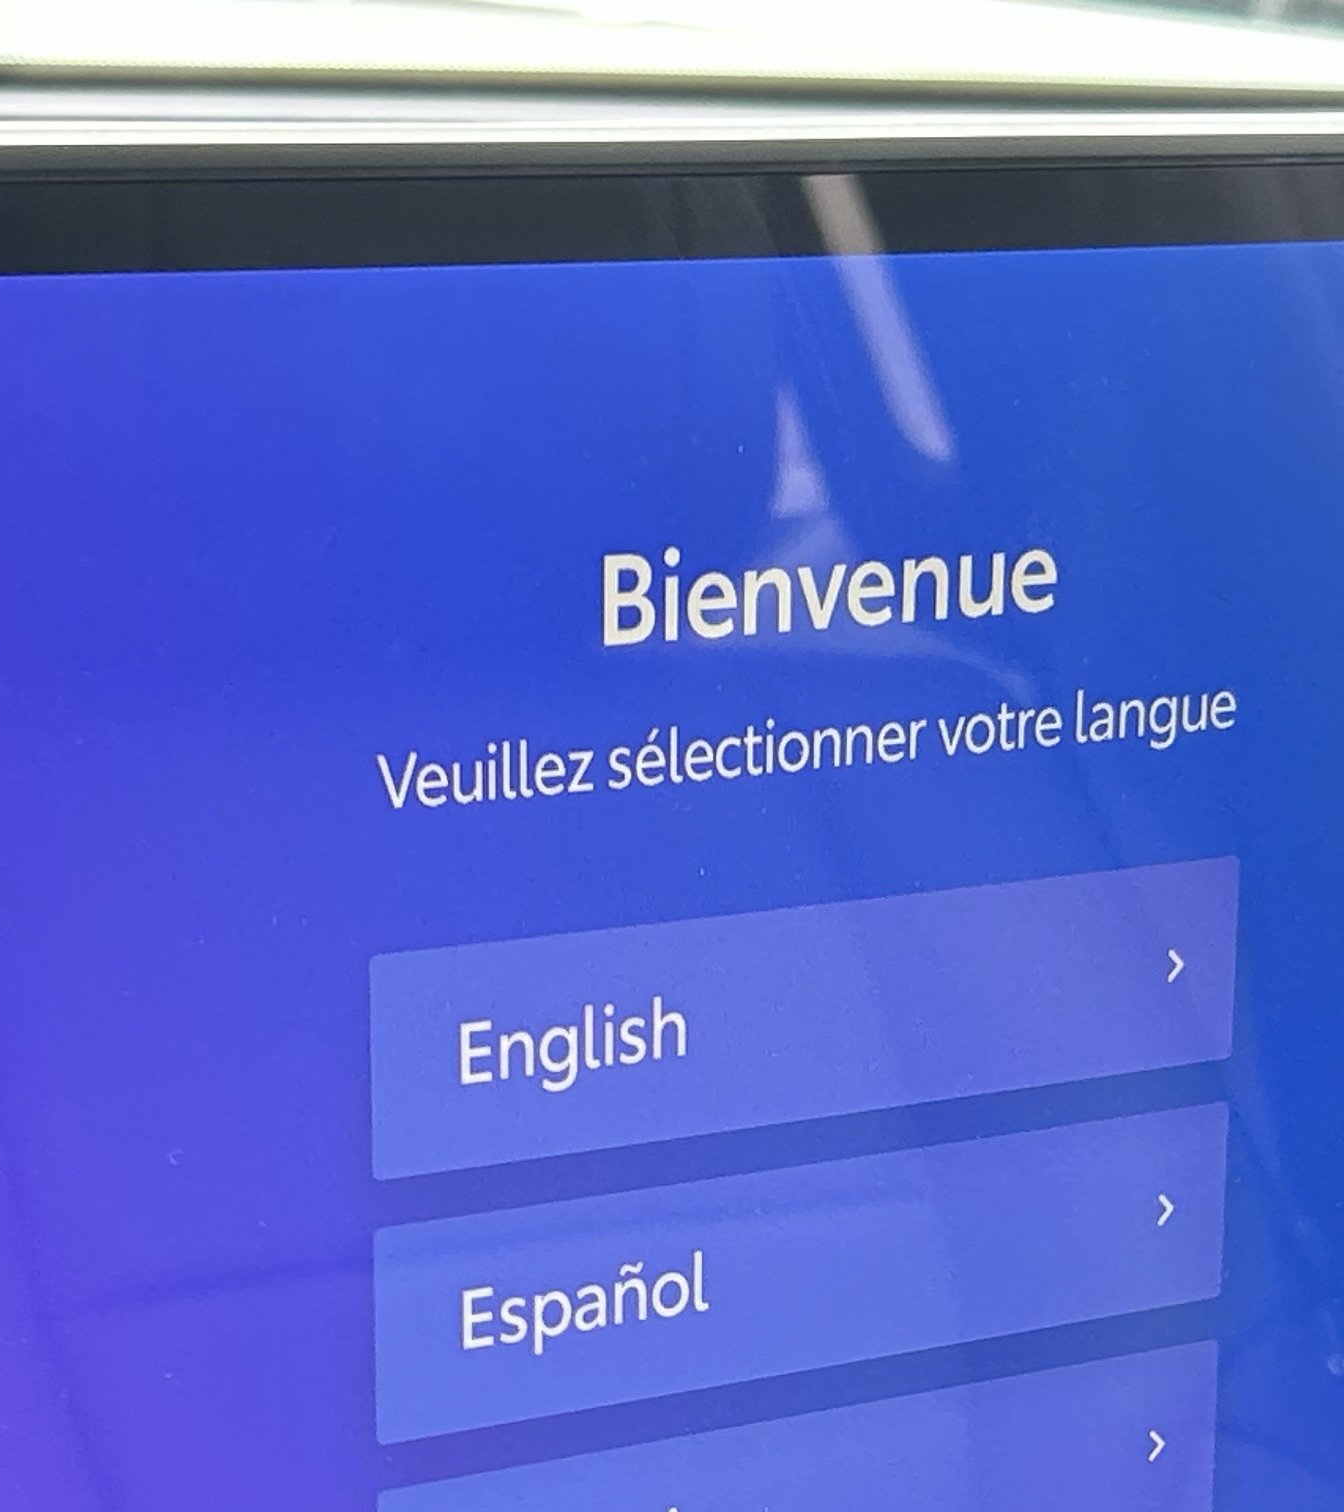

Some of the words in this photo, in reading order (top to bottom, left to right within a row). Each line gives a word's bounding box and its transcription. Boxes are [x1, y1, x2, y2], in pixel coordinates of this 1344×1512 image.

[601, 546, 1058, 647] Bienvenue
[377, 741, 594, 809] Veuillez
[607, 717, 927, 788] sélectionner
[937, 700, 1062, 755] votre
[1073, 688, 1237, 750] langue
[458, 997, 688, 1091] English
[461, 1250, 709, 1355] Español
